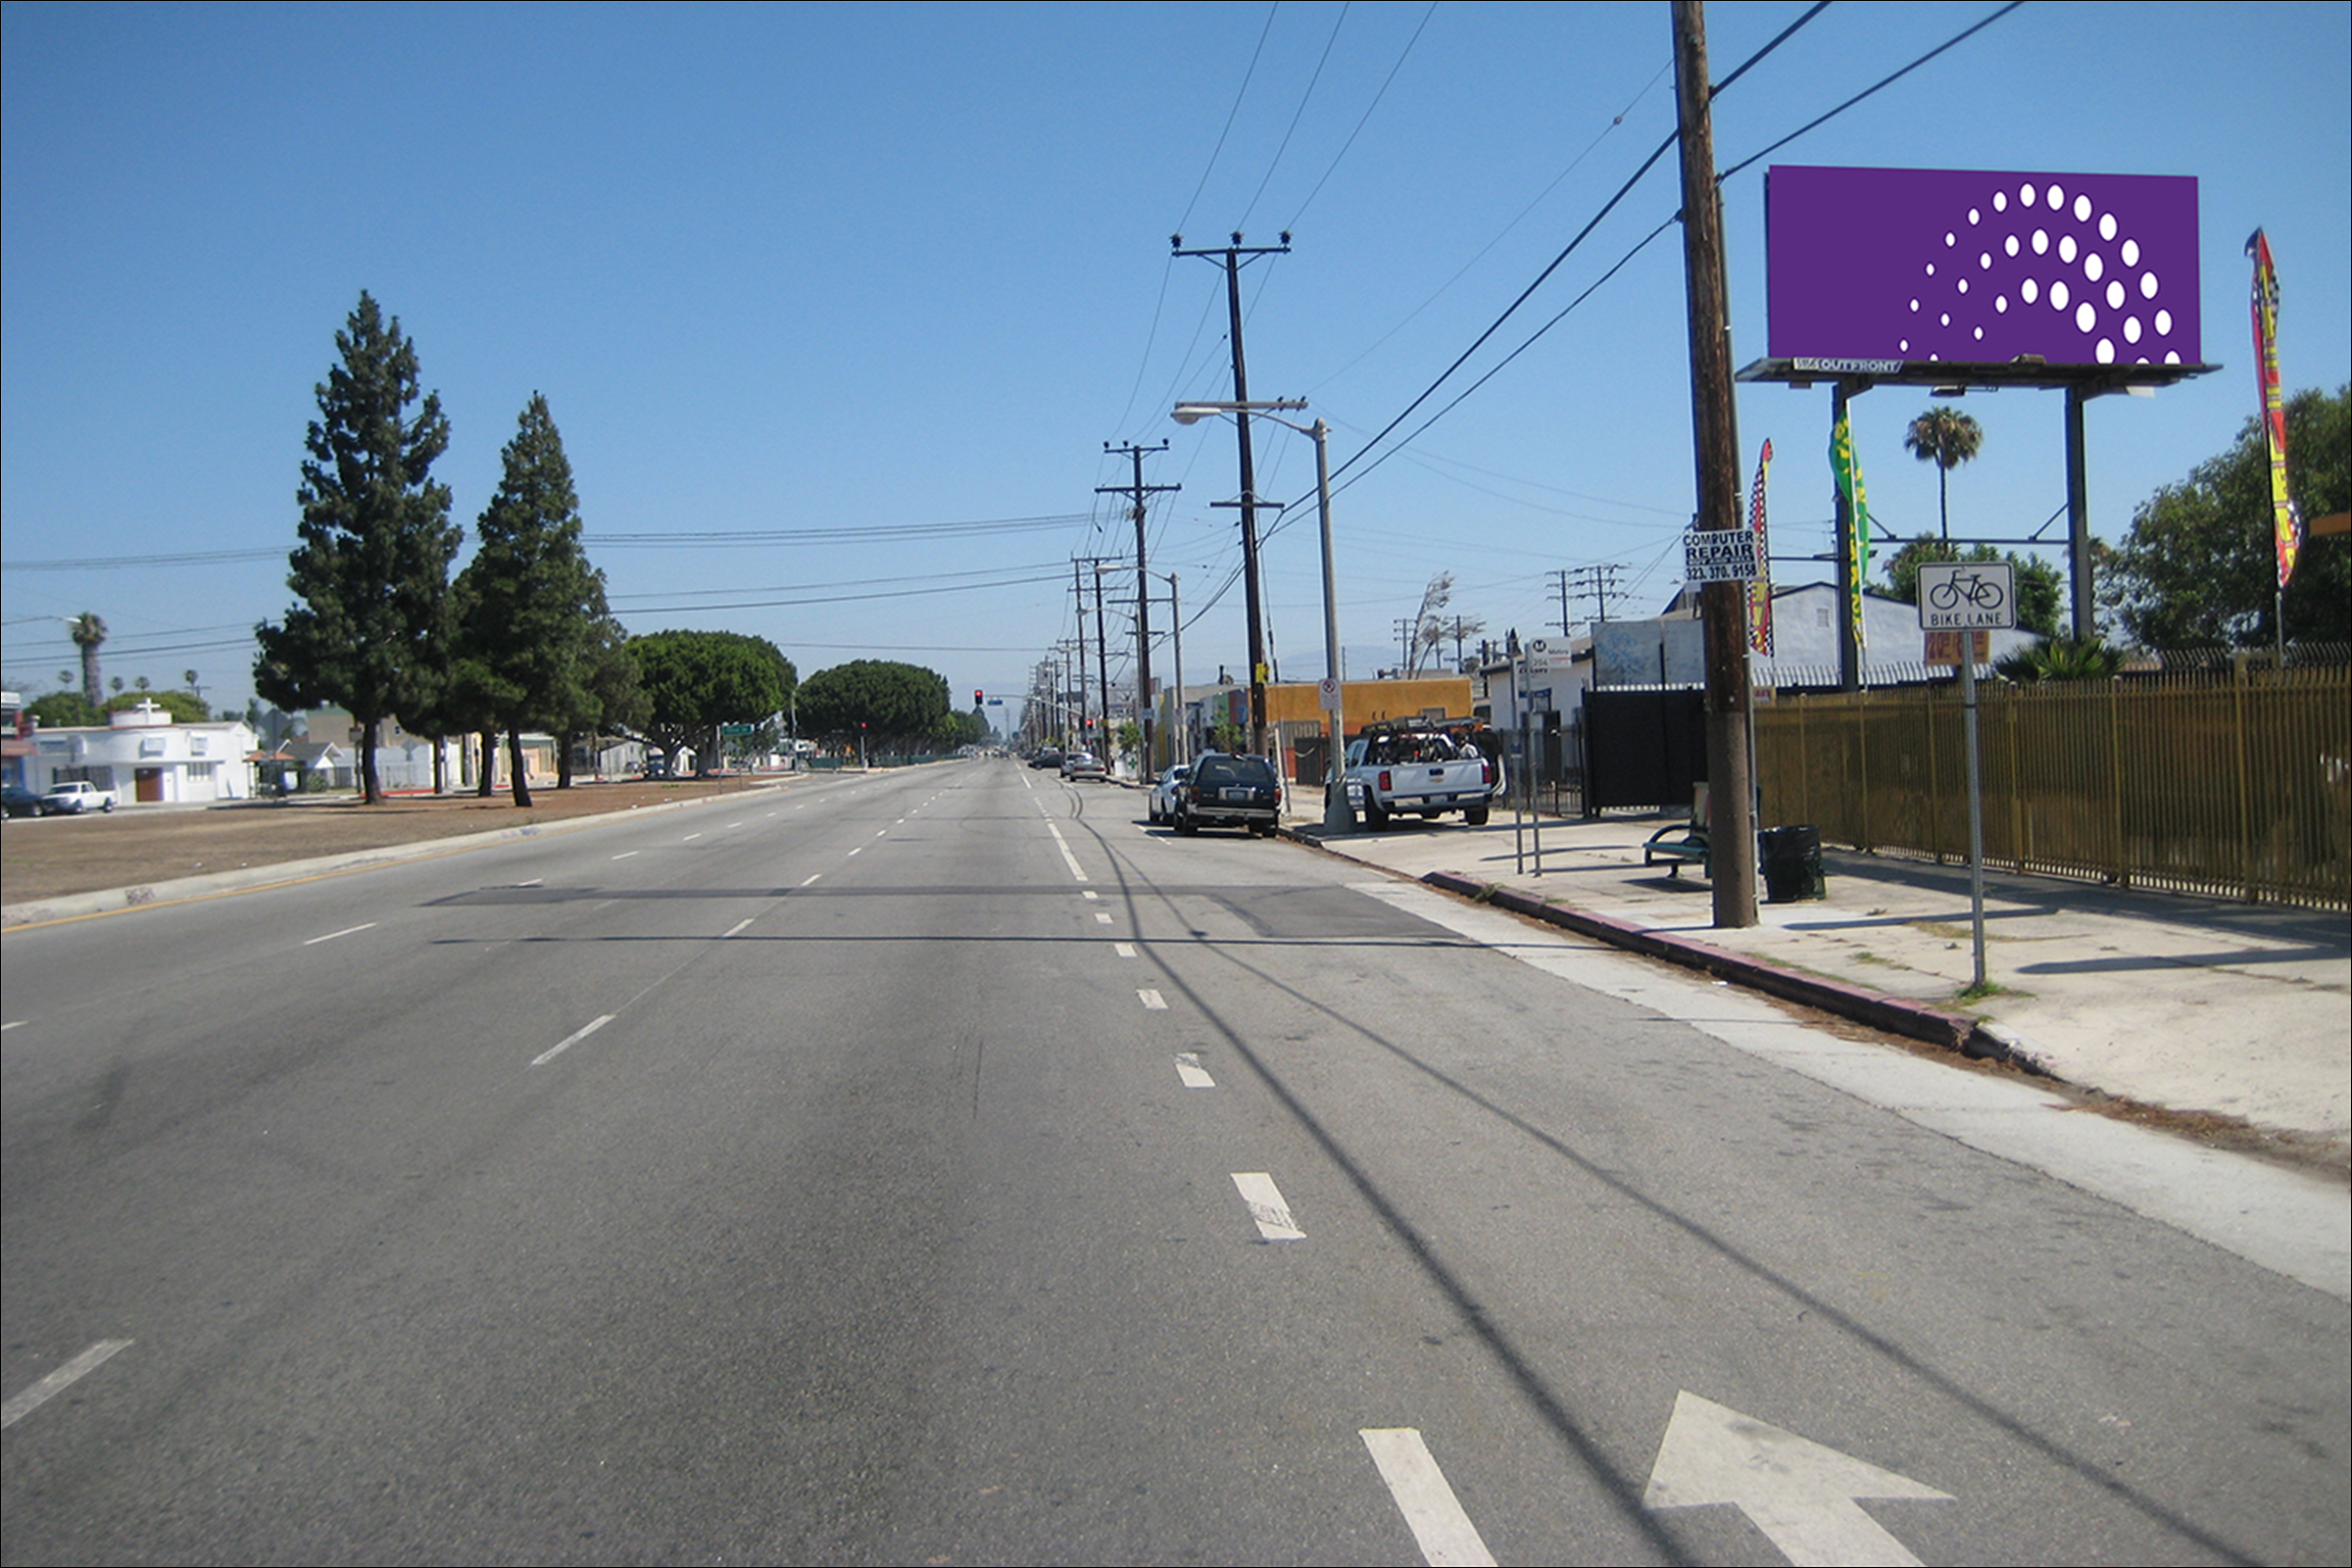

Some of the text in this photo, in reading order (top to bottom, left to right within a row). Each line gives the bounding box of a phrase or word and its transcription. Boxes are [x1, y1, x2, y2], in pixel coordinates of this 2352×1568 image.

[1821, 359, 1897, 372] OUTFRONT
[1683, 530, 1754, 547] COMPUTER
[1686, 544, 1753, 559] REPAIR
[1931, 612, 2002, 626] BIKE LANE
